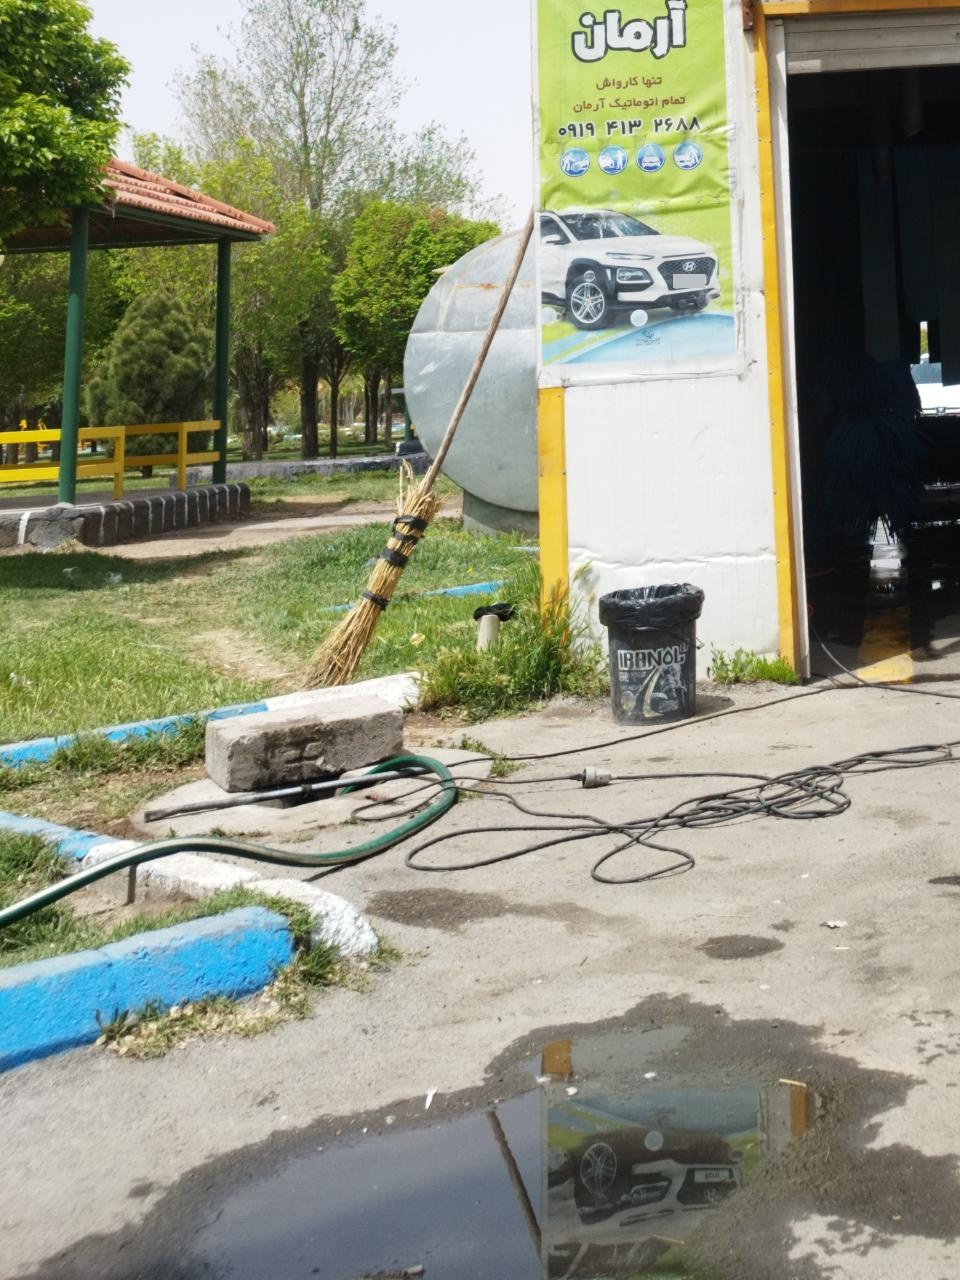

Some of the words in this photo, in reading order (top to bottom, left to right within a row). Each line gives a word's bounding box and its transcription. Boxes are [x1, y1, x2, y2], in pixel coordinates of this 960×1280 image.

[596, 76, 638, 90] کارواش
[642, 76, 662, 88] تنها
[573, 98, 605, 113] آرمان
[609, 98, 658, 111] اتوماتیک
[661, 96, 686, 108] تمام
[558, 122, 595, 138] ۰۹۱۹
[606, 119, 642, 135] ۴۱۳
[654, 117, 700, 133] ۲۶۸۸
[617, 643, 686, 670] IRANOL
